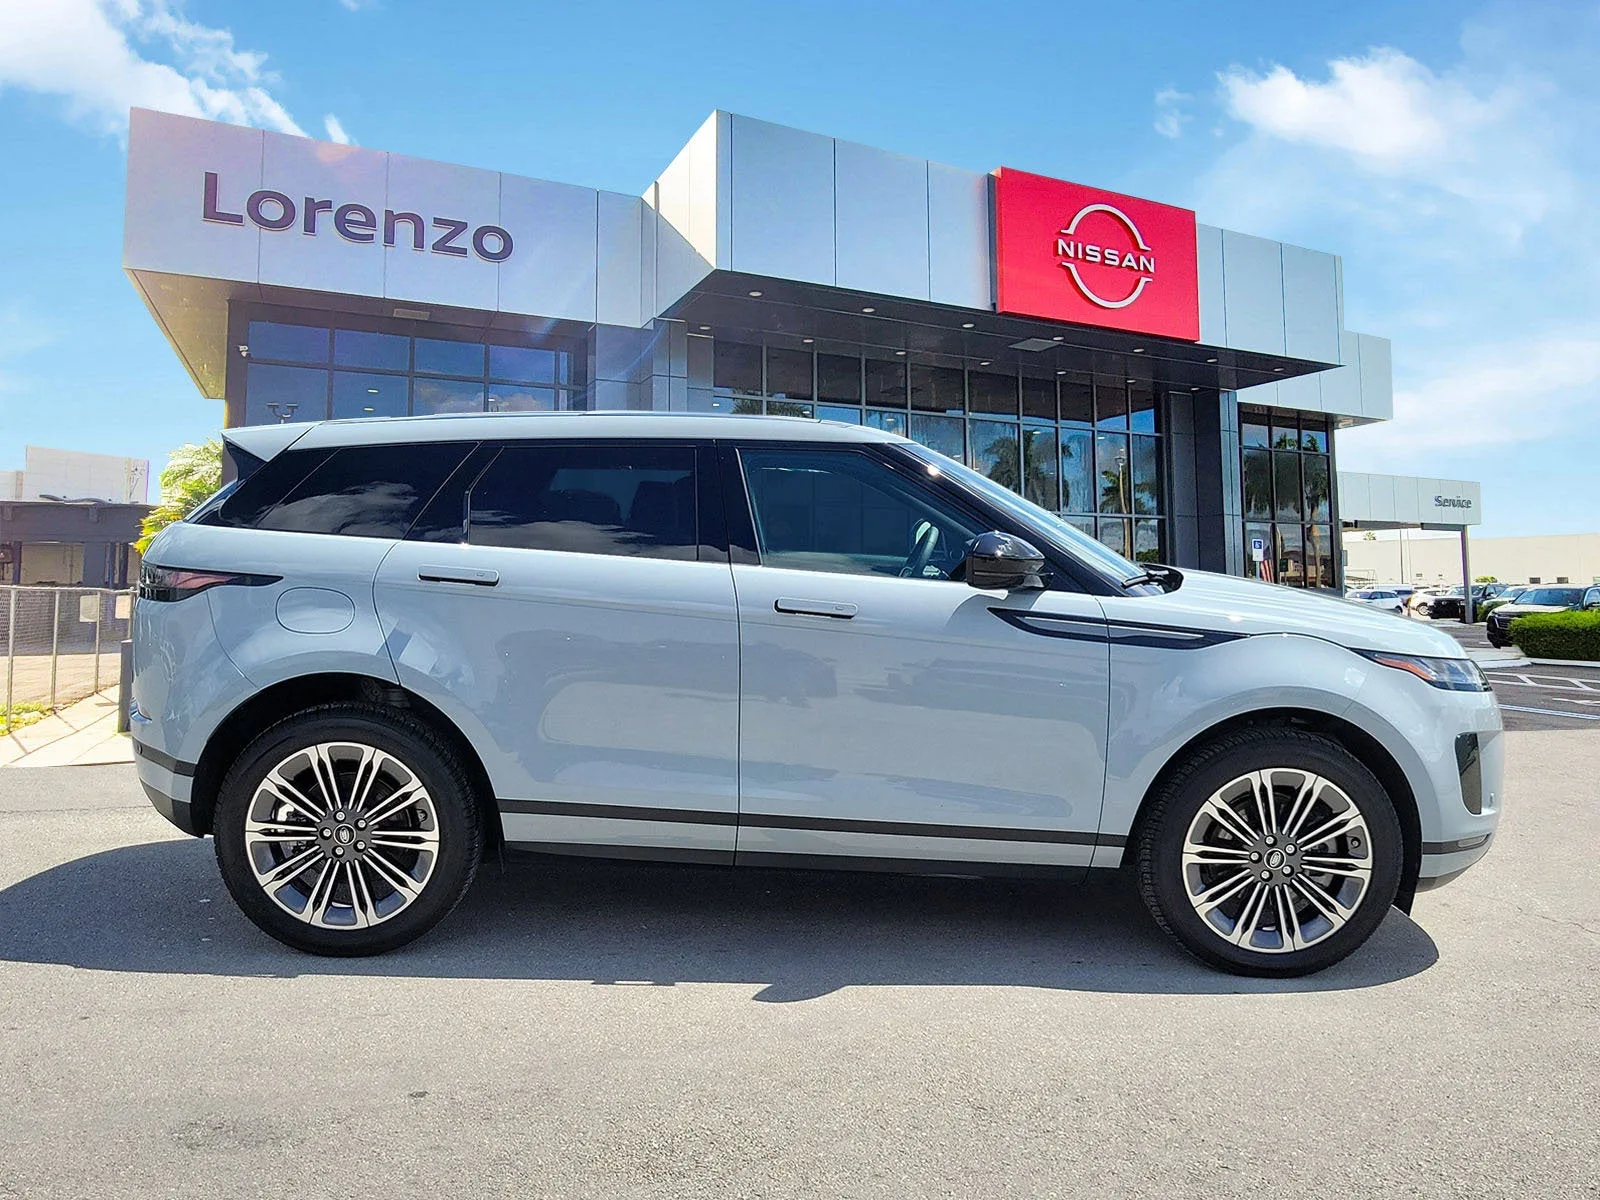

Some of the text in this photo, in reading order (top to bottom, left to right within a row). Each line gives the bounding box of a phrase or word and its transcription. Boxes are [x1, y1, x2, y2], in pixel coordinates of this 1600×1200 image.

[202, 171, 515, 262] Lorenzo
[1057, 238, 1155, 273] NISSAN
[1434, 495, 1472, 509] Service
